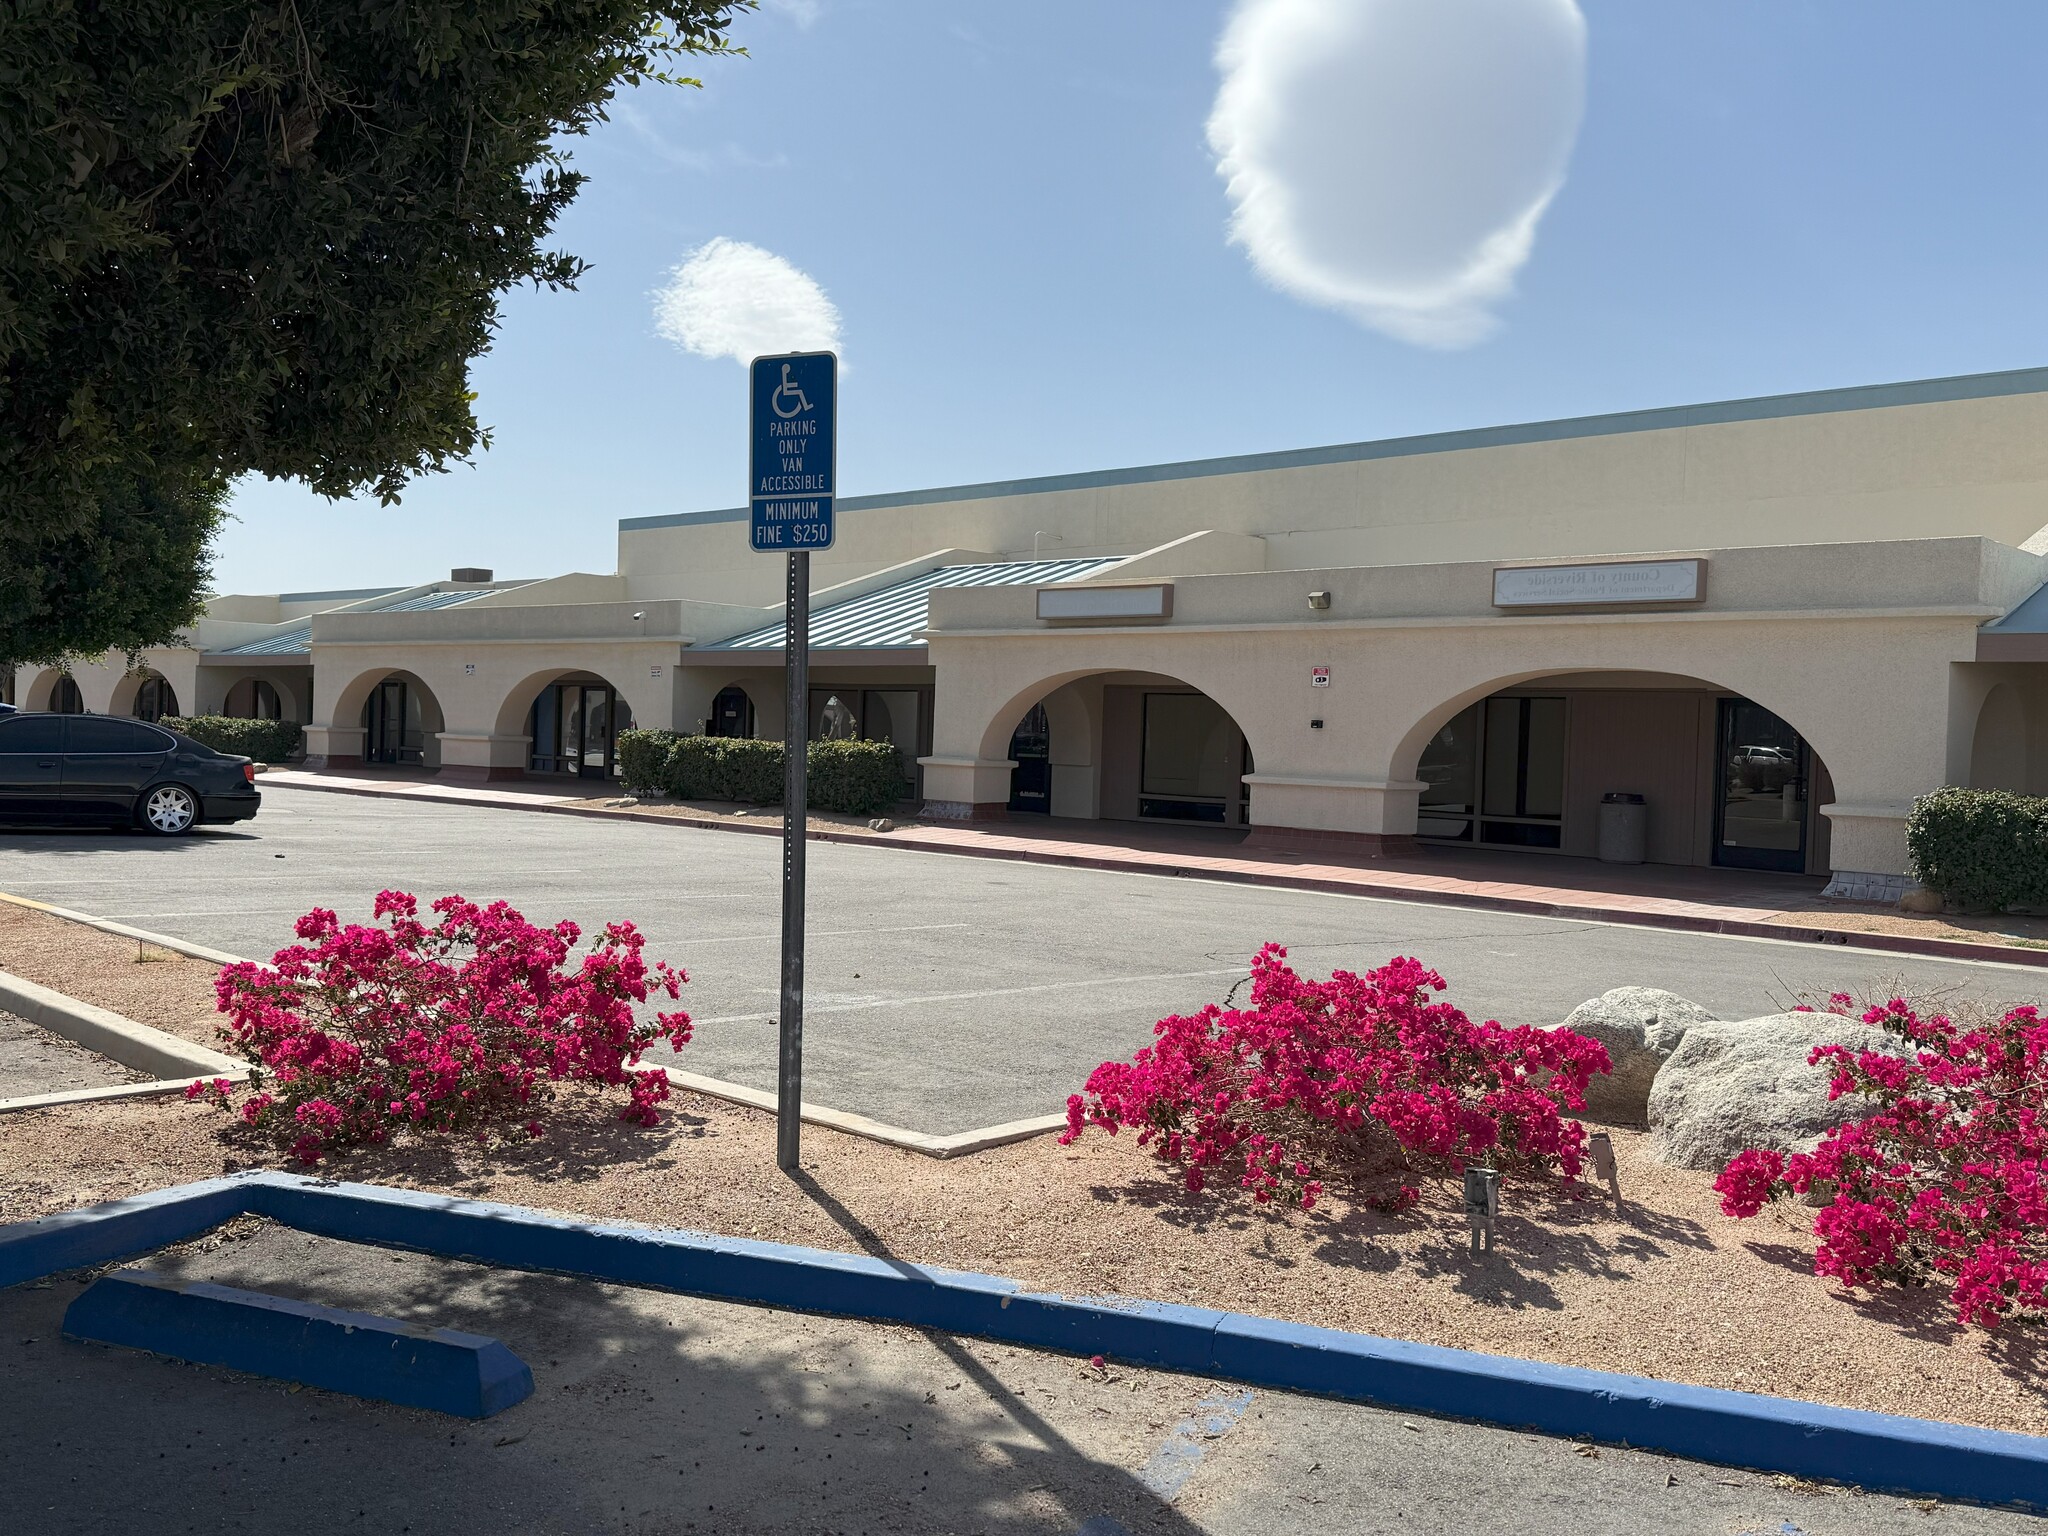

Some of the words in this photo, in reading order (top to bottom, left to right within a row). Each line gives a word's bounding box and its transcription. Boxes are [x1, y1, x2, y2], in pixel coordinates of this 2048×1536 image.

[770, 420, 816, 437] PARKING
[779, 439, 807, 454] ONLY
[782, 457, 803, 472] VAN
[761, 474, 824, 491] ACCESSIBLE
[765, 501, 818, 520] MINIMUM
[757, 525, 783, 543] FINE
[792, 523, 827, 544] $250
